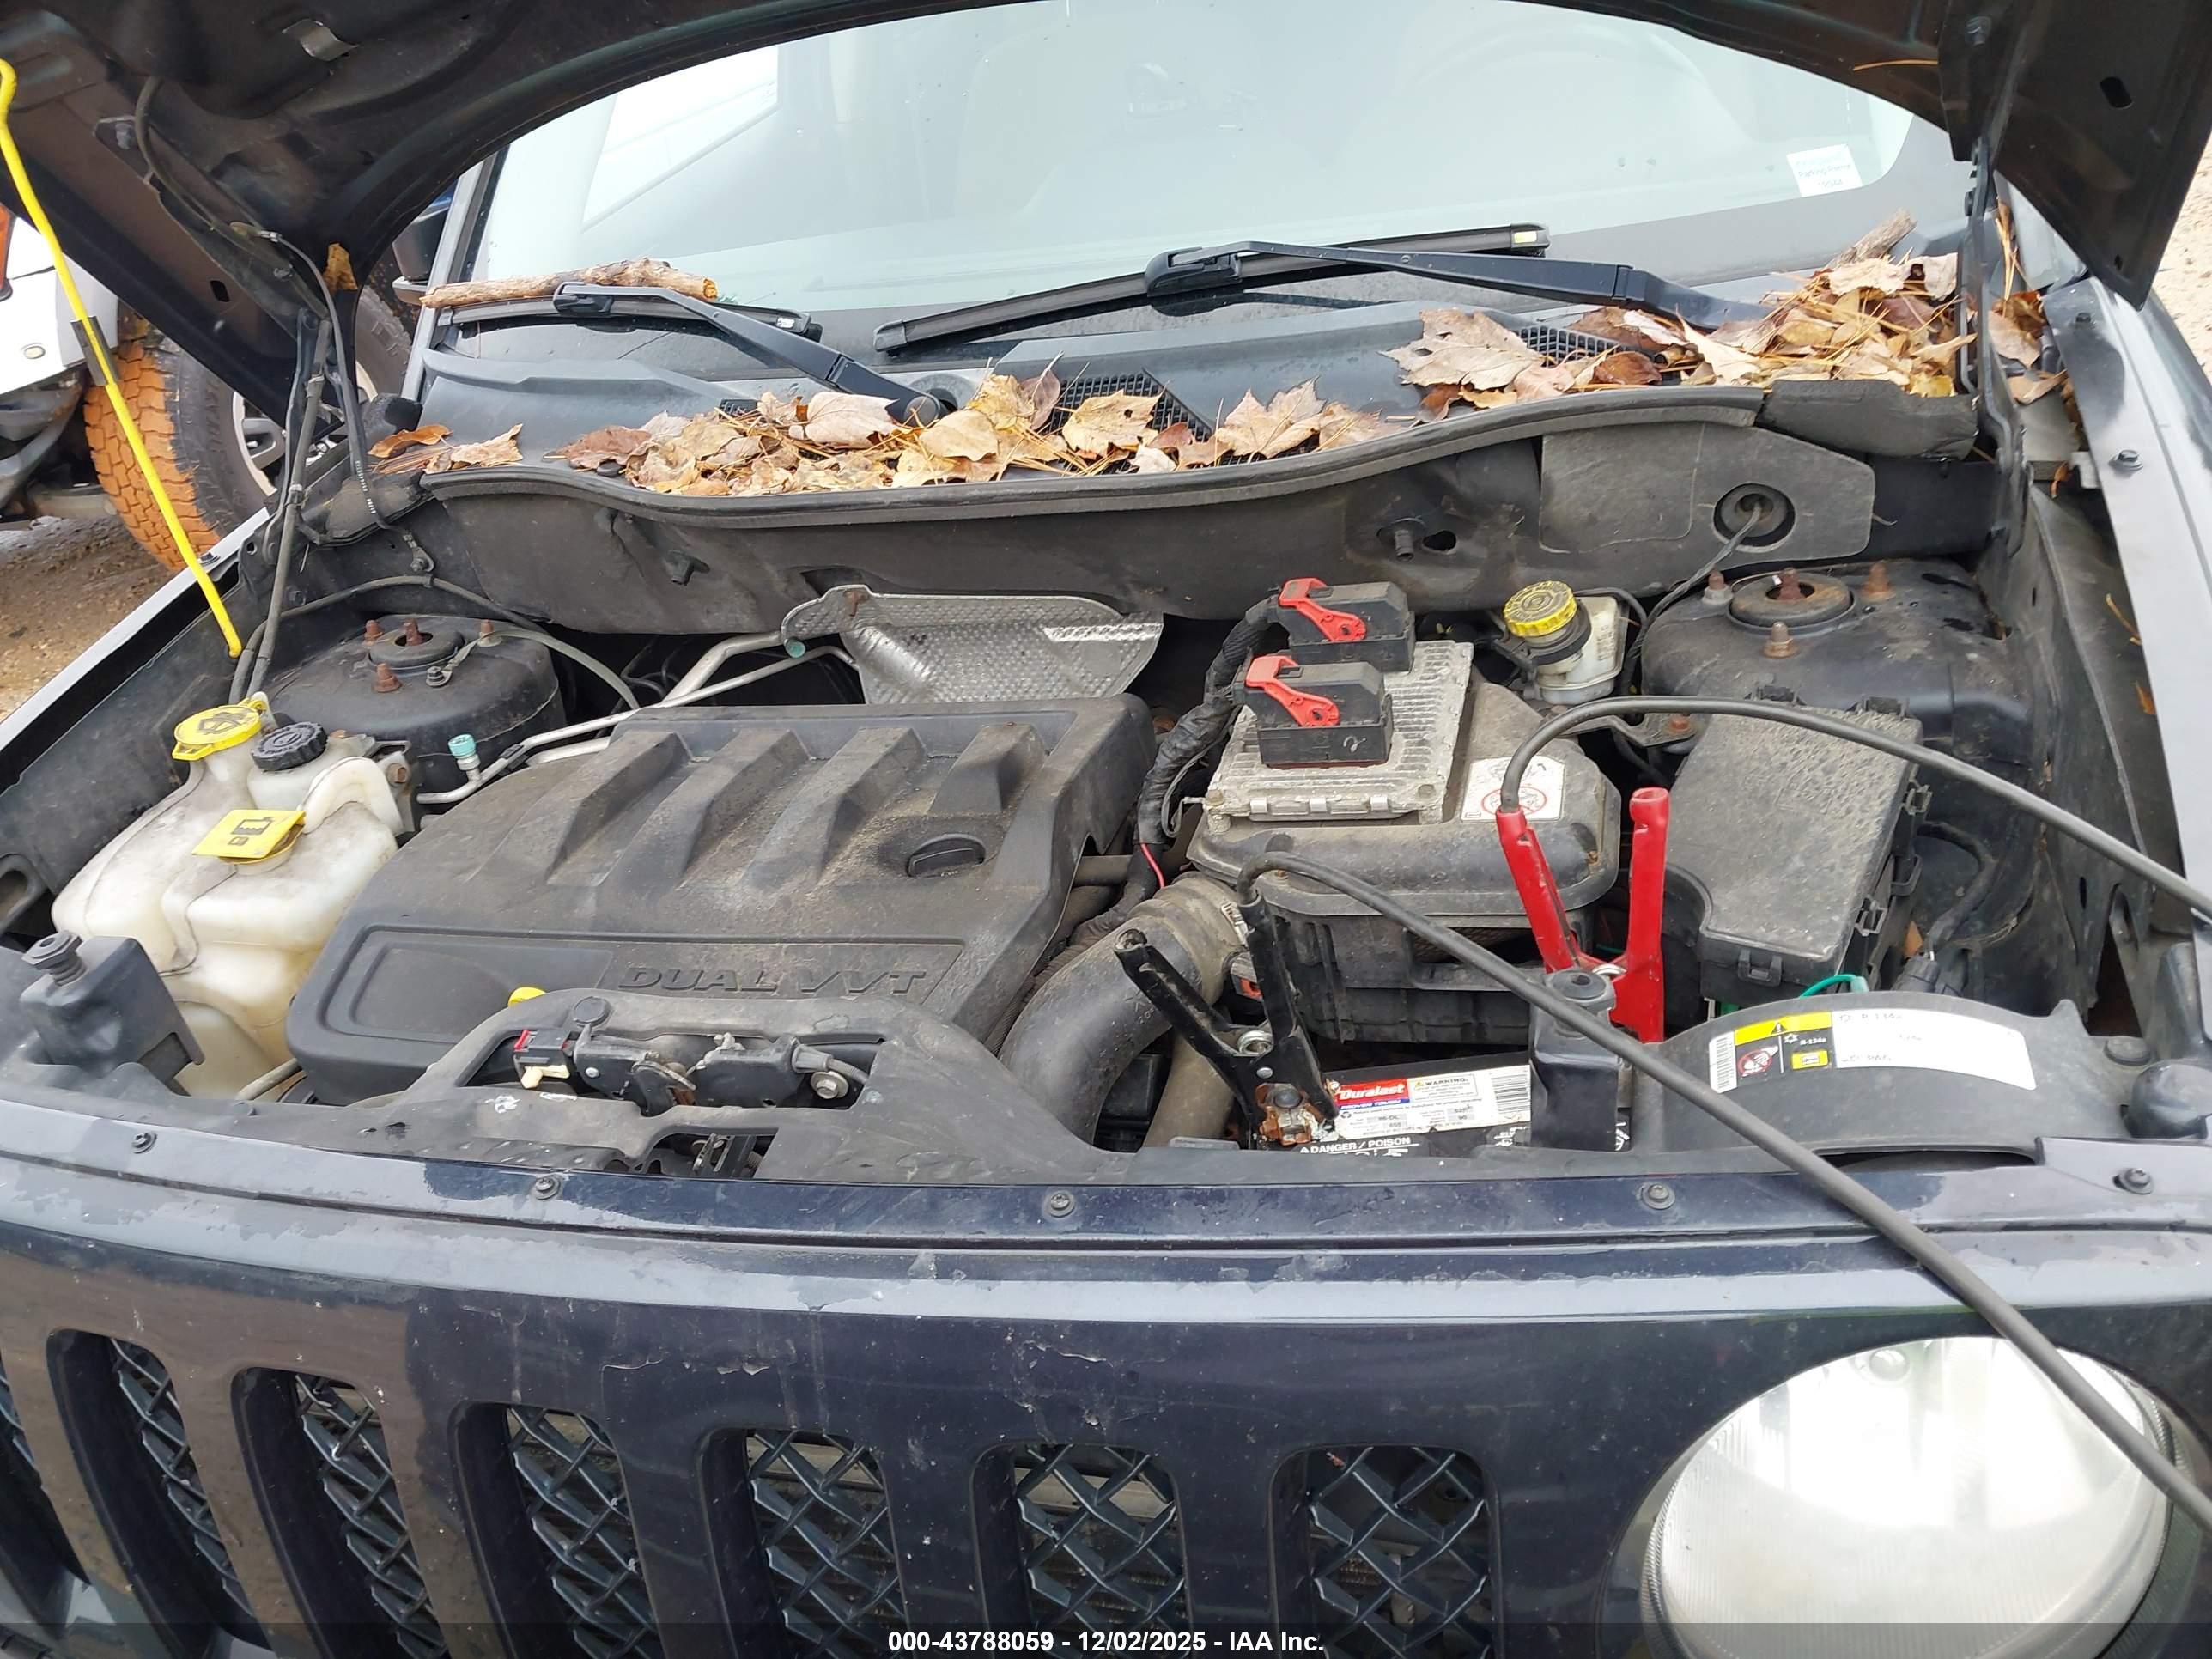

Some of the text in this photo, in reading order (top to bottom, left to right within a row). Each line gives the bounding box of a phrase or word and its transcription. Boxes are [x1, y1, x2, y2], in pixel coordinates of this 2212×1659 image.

[618, 967, 927, 994] DUAL VVT
[1336, 1083, 1406, 1100] Duralast
[1310, 1142, 1357, 1154] DANGER
[1368, 1136, 1411, 1148] POISON
